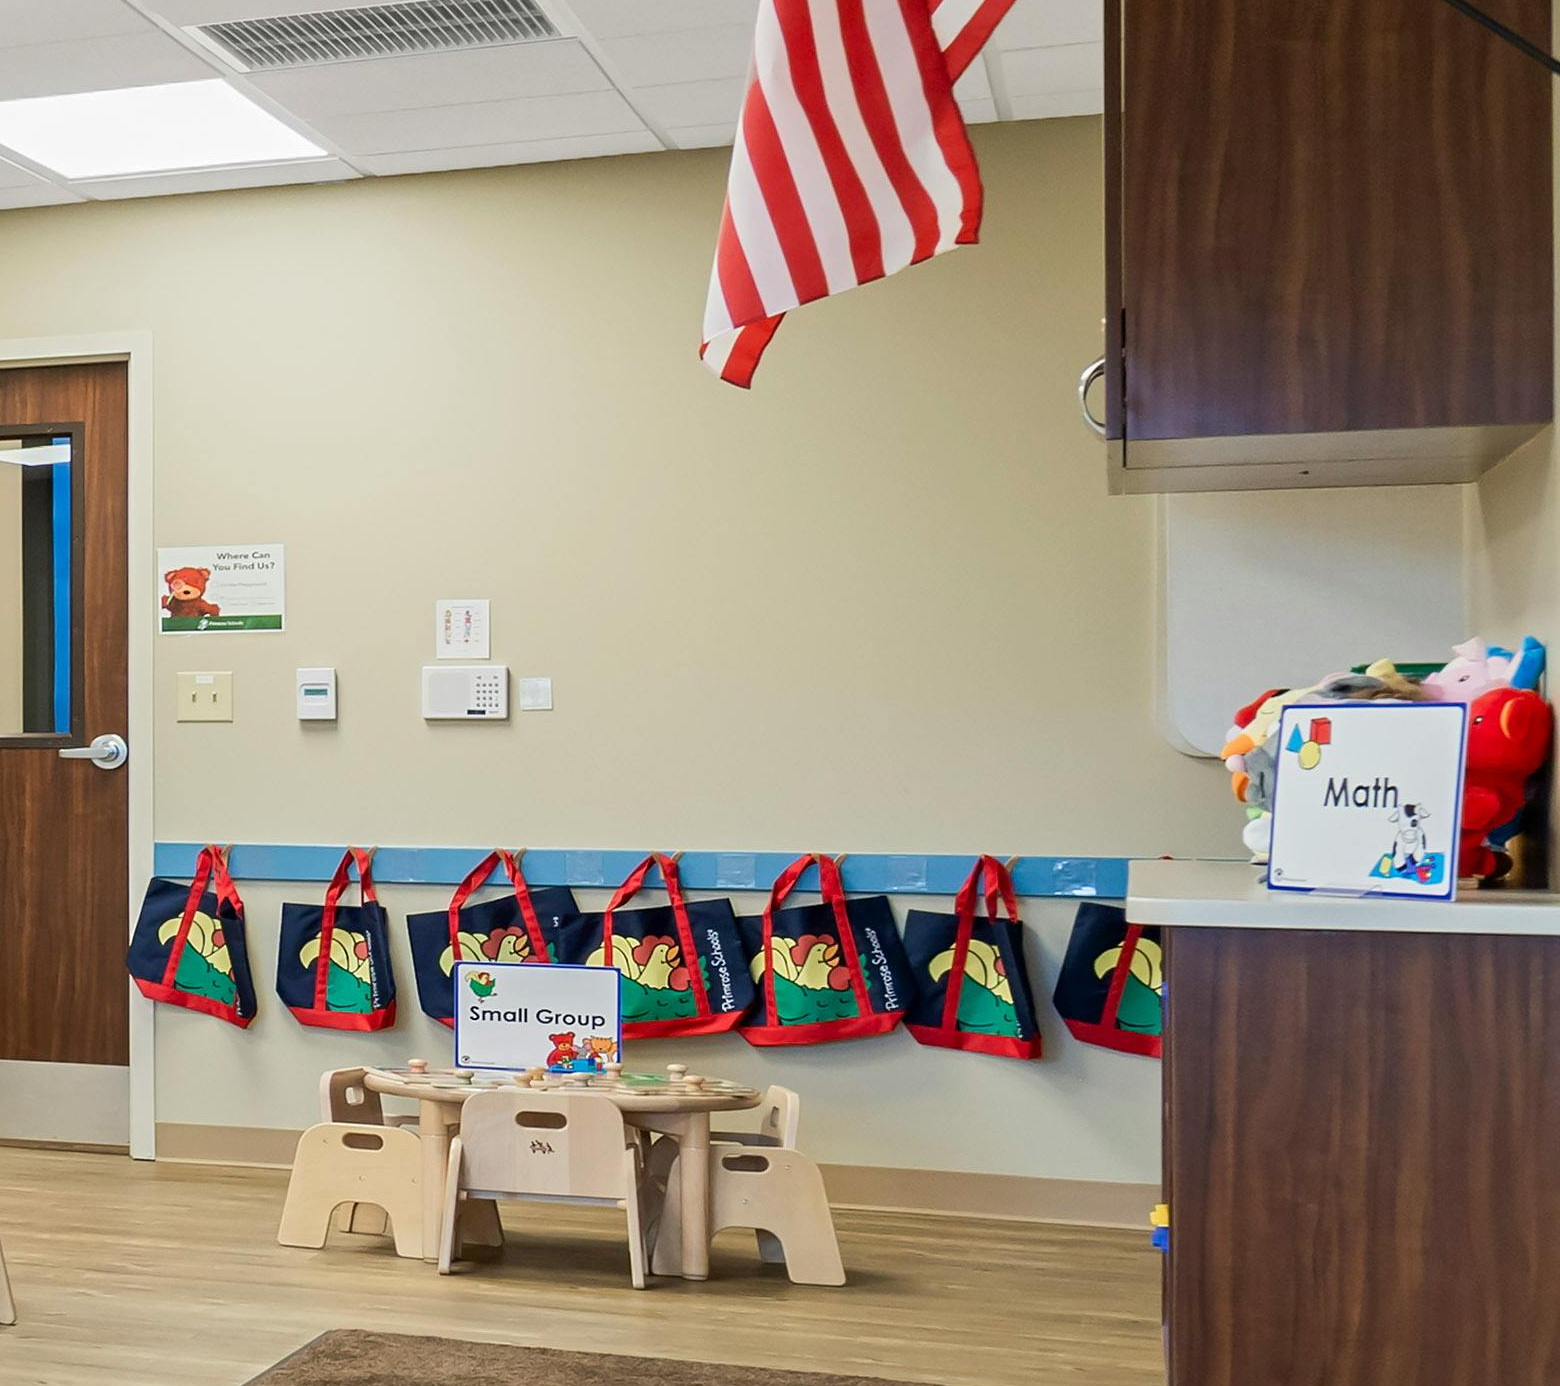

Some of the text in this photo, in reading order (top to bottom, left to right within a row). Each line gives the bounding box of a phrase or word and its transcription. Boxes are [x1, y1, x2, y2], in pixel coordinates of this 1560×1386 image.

[212, 561, 275, 571] You Find Us?
[216, 551, 271, 560] Where Can
[1323, 777, 1399, 808] Math
[718, 966, 736, 1013] Primrose
[879, 965, 899, 1012] Primrose
[469, 1006, 606, 1030] Small Group
